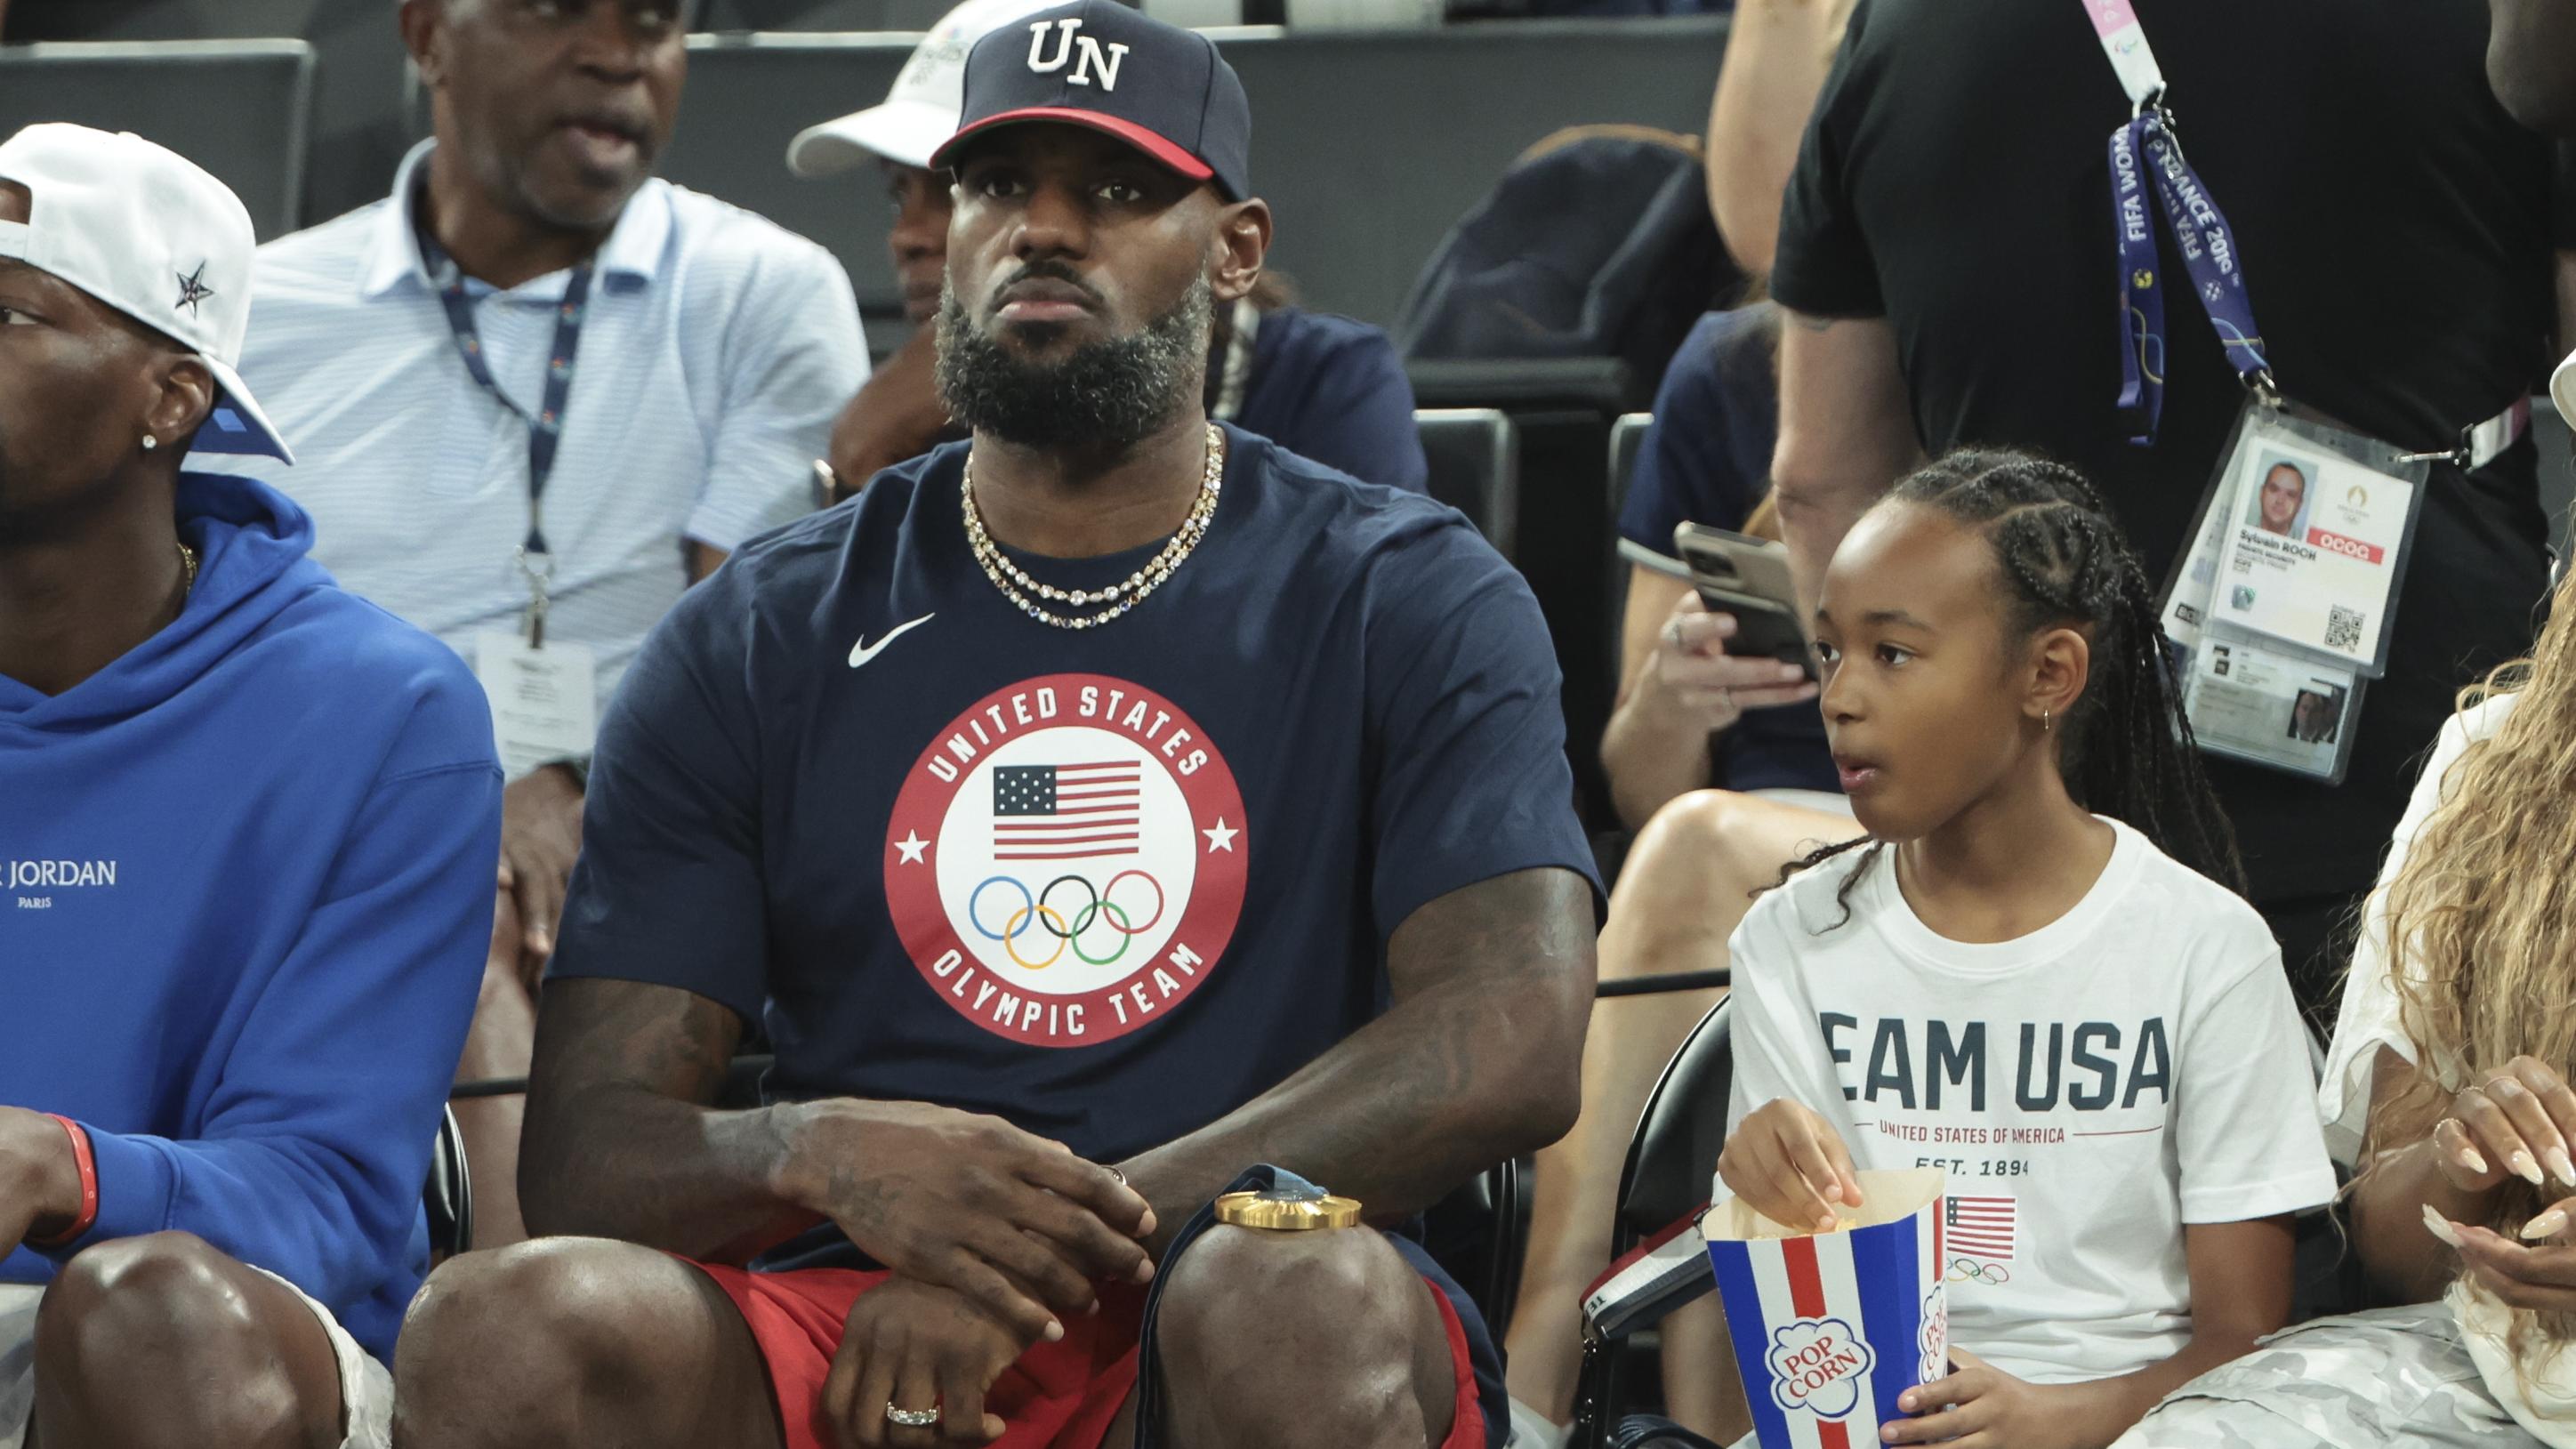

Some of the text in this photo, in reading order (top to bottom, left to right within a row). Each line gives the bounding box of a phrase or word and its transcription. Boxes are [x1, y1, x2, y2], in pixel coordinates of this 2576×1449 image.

[1027, 18, 1130, 92] UN
[2113, 124, 2146, 242] FIFA WOM
[2177, 213, 2202, 261] FIFA
[2205, 225, 2233, 276] 2019
[2282, 542, 2317, 562] ROCH
[928, 686, 1208, 783] UNITED STATES
[9, 860, 117, 890] JORDAN
[18, 897, 52, 908] PARIS
[933, 942, 1203, 1036] OLYMPIC TEAM
[1820, 1011, 2170, 1112] EAM USA
[1880, 1119, 2065, 1144] UNITED STATES OF AMERICA
[1783, 1336, 1833, 1376] POP
[1789, 1348, 1858, 1398] CORN
